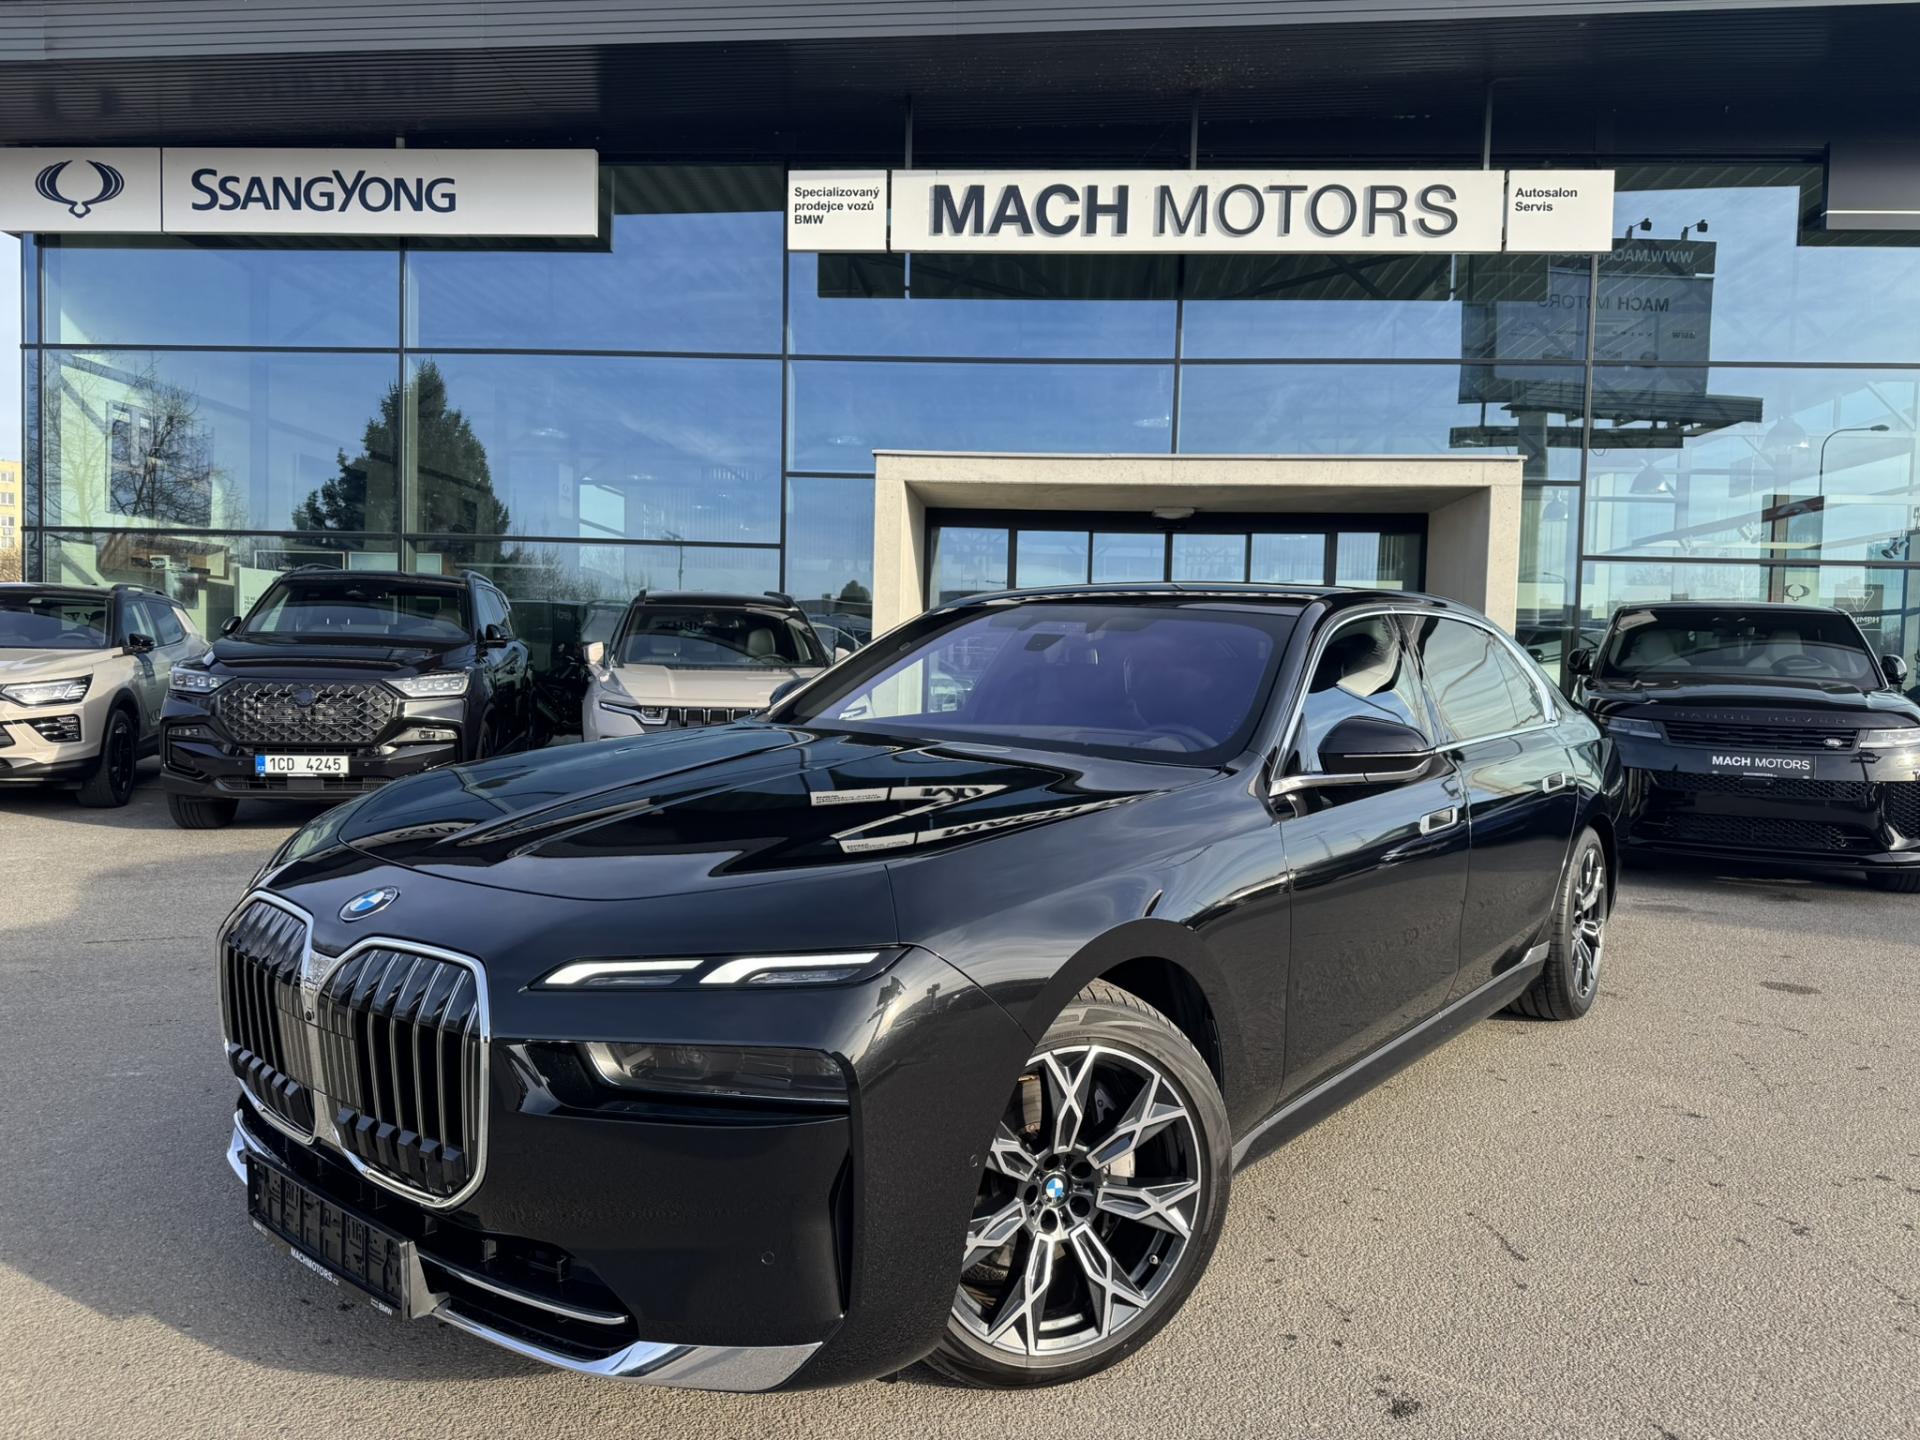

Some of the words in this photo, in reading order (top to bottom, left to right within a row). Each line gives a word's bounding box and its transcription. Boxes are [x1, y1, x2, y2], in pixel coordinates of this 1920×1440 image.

[794, 186, 880, 199] Specializovaný
[1515, 187, 1578, 198] Autosalon
[794, 201, 844, 213] prodejce
[847, 201, 874, 211] vozů
[929, 184, 1129, 237] MACH
[1153, 184, 1459, 237] MOTORS
[1515, 201, 1553, 211] Servis
[794, 214, 824, 225] BMW
[269, 758, 294, 771] 1CD
[306, 758, 341, 771] 4245
[1712, 755, 1750, 767] MACH
[1755, 758, 1810, 770] MOTORS
